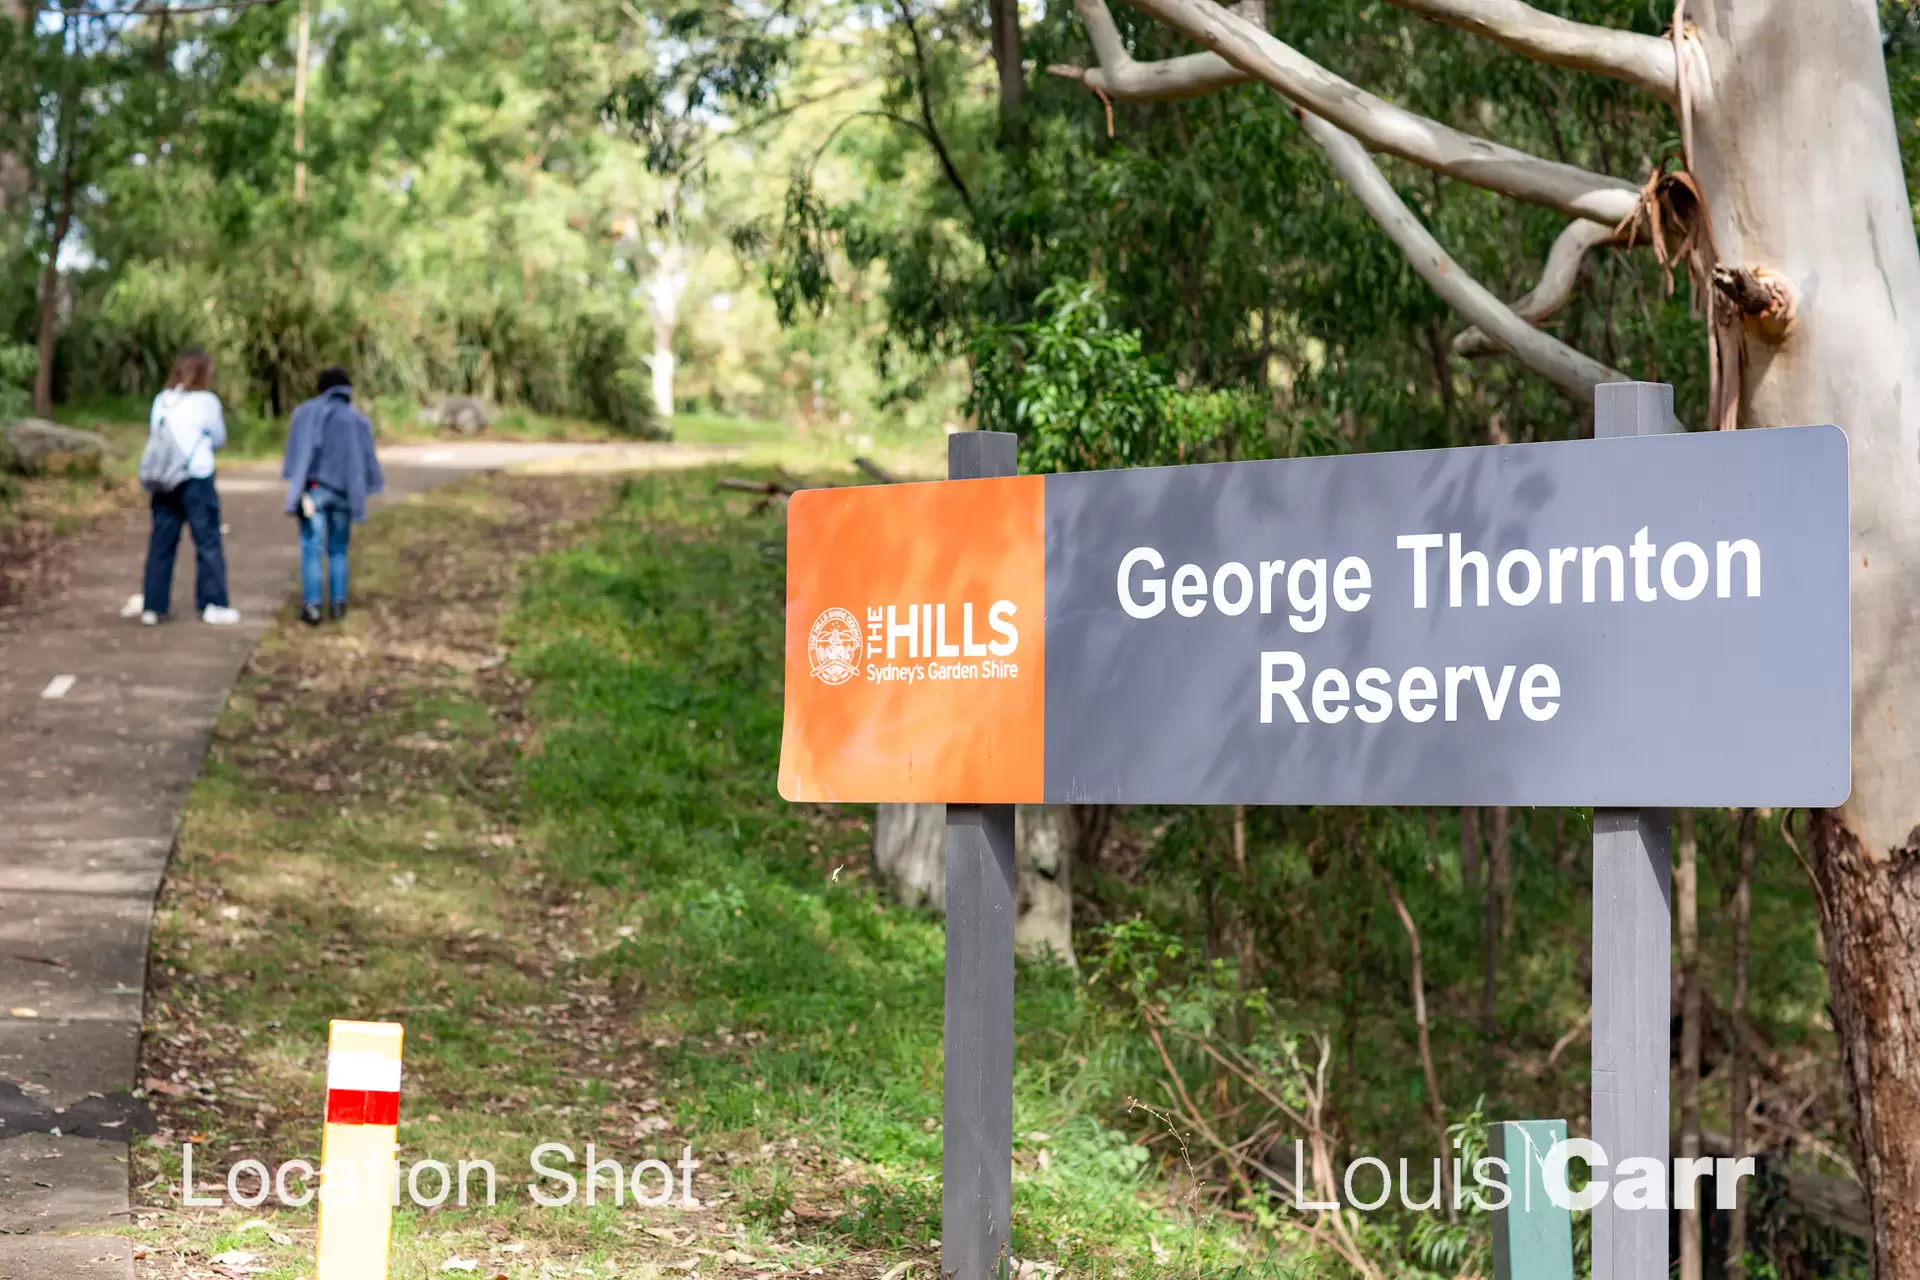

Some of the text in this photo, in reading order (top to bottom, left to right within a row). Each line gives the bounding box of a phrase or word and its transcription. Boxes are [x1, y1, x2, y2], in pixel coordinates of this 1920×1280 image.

[1116, 525, 1762, 633] George Thornton
[867, 606, 883, 658] THE
[887, 600, 1019, 658] HILLS
[928, 661, 979, 680] Garden
[982, 660, 1019, 679] Shire
[1259, 651, 1561, 723] Reserve
